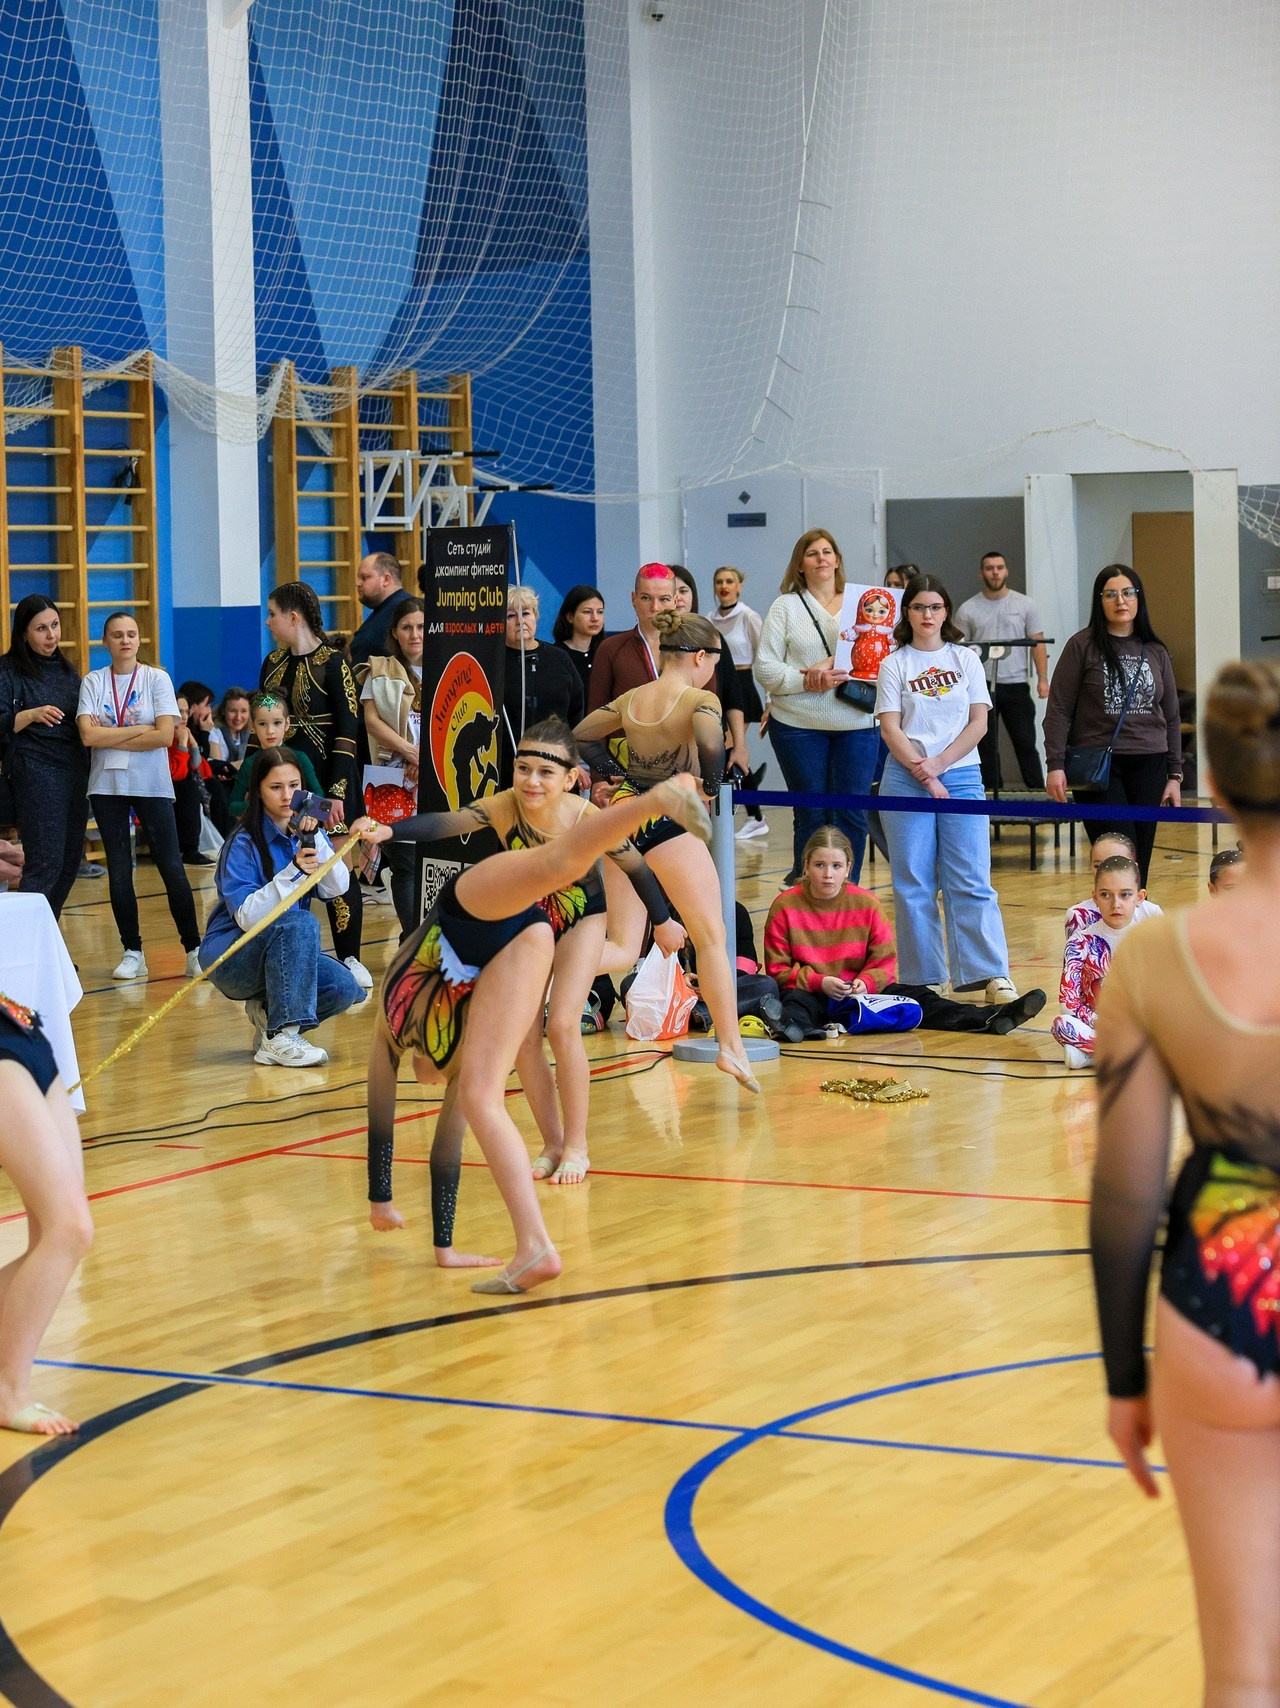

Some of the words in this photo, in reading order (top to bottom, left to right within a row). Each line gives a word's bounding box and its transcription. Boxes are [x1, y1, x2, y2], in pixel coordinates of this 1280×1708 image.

[447, 541, 465, 556] Сеть
[466, 539, 492, 557] студий
[434, 564, 470, 578] джампинг
[470, 562, 505, 579] фитнеса
[436, 587, 477, 612] Jumping
[478, 586, 504, 607] Club
[428, 622, 444, 634] для
[445, 622, 478, 636] взрослых
[478, 622, 484, 633] и
[435, 664, 472, 731] Jumping
[451, 700, 468, 732] Club
